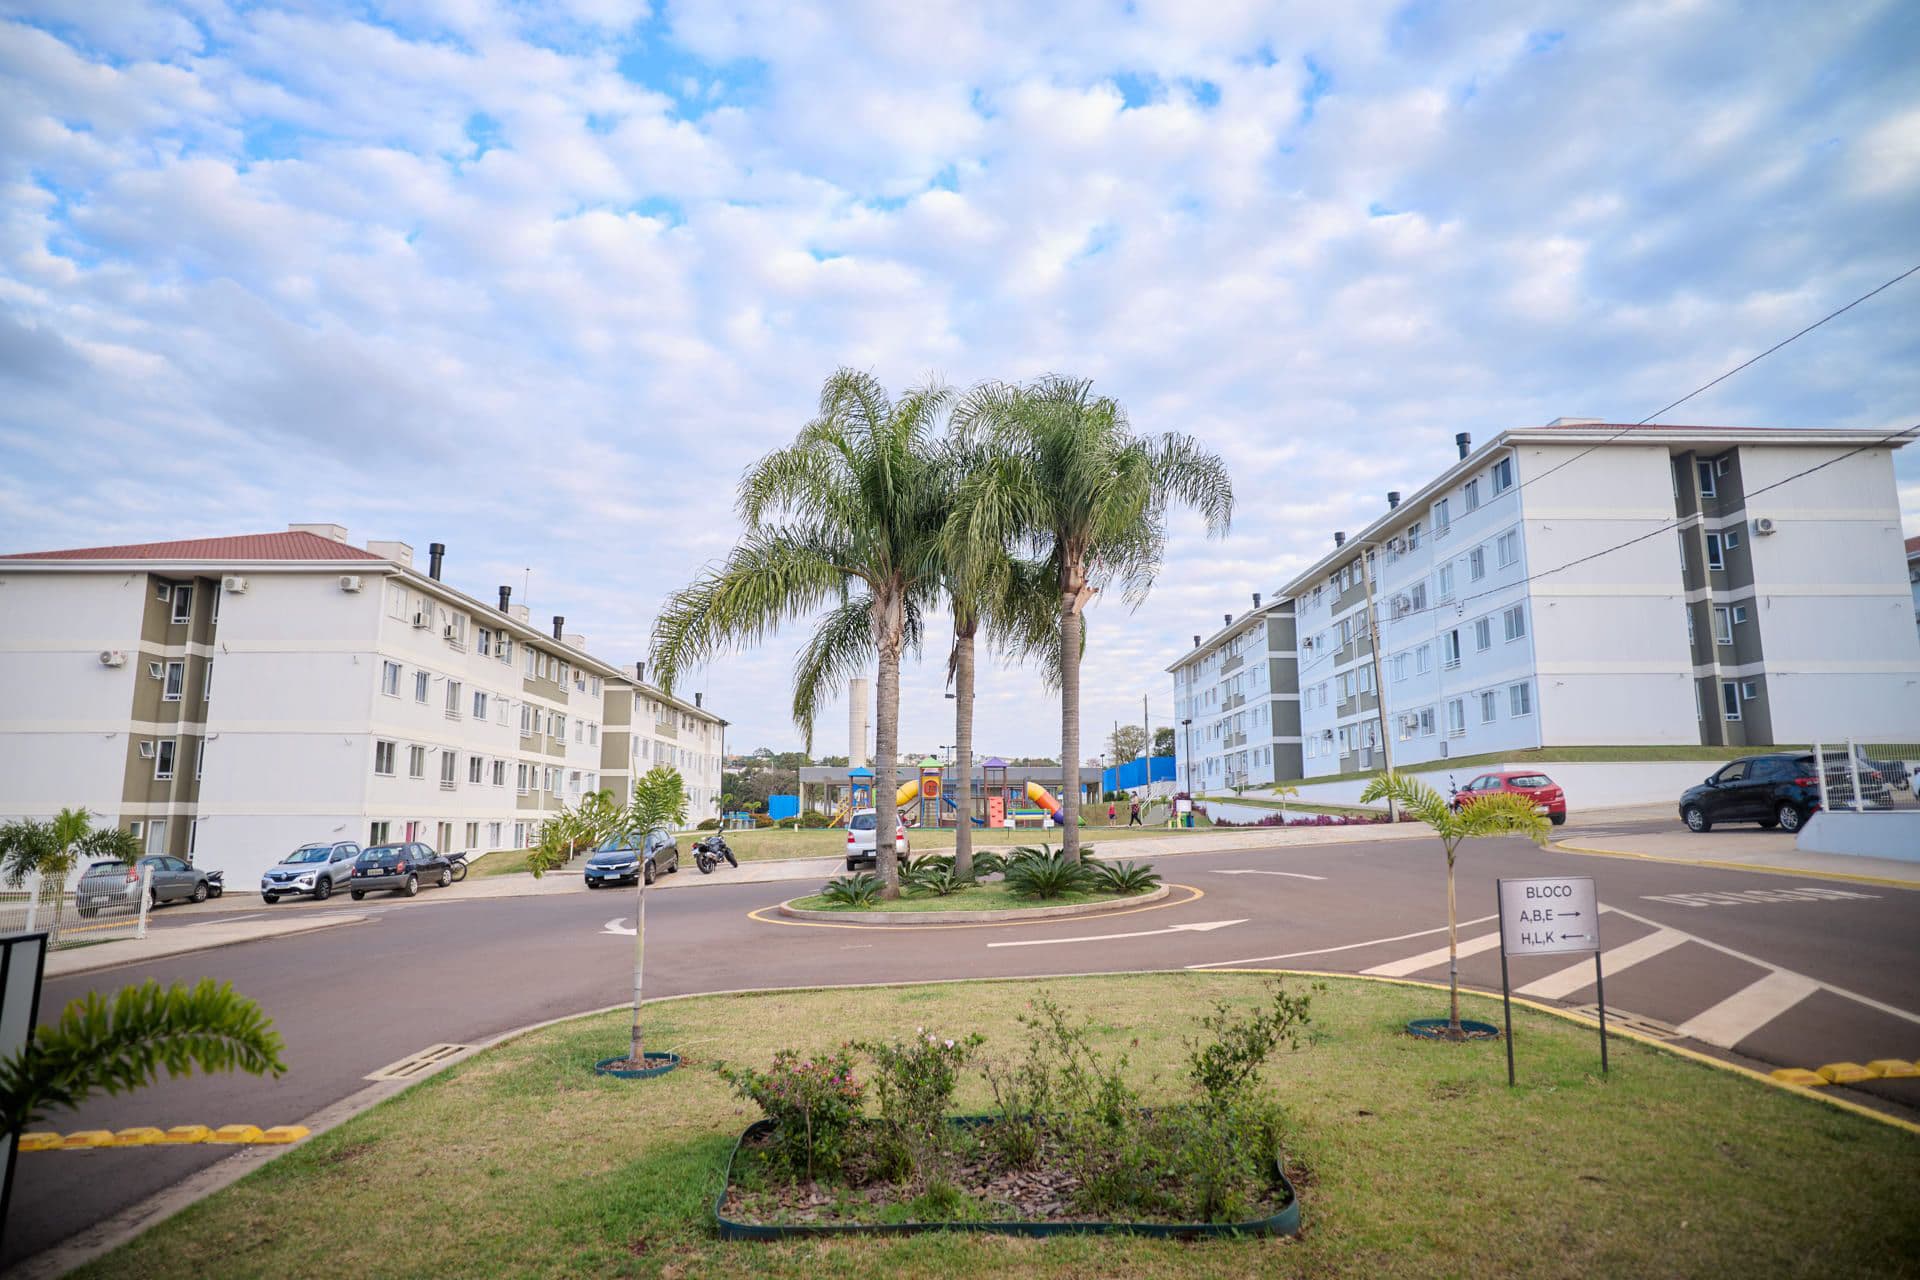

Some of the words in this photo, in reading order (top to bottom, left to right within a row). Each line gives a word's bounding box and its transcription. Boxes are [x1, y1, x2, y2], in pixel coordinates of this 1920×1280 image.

[1526, 885, 1572, 899] BLOCO
[1520, 909, 1553, 924] A,B,E
[1521, 931, 1555, 946] H,L,K
